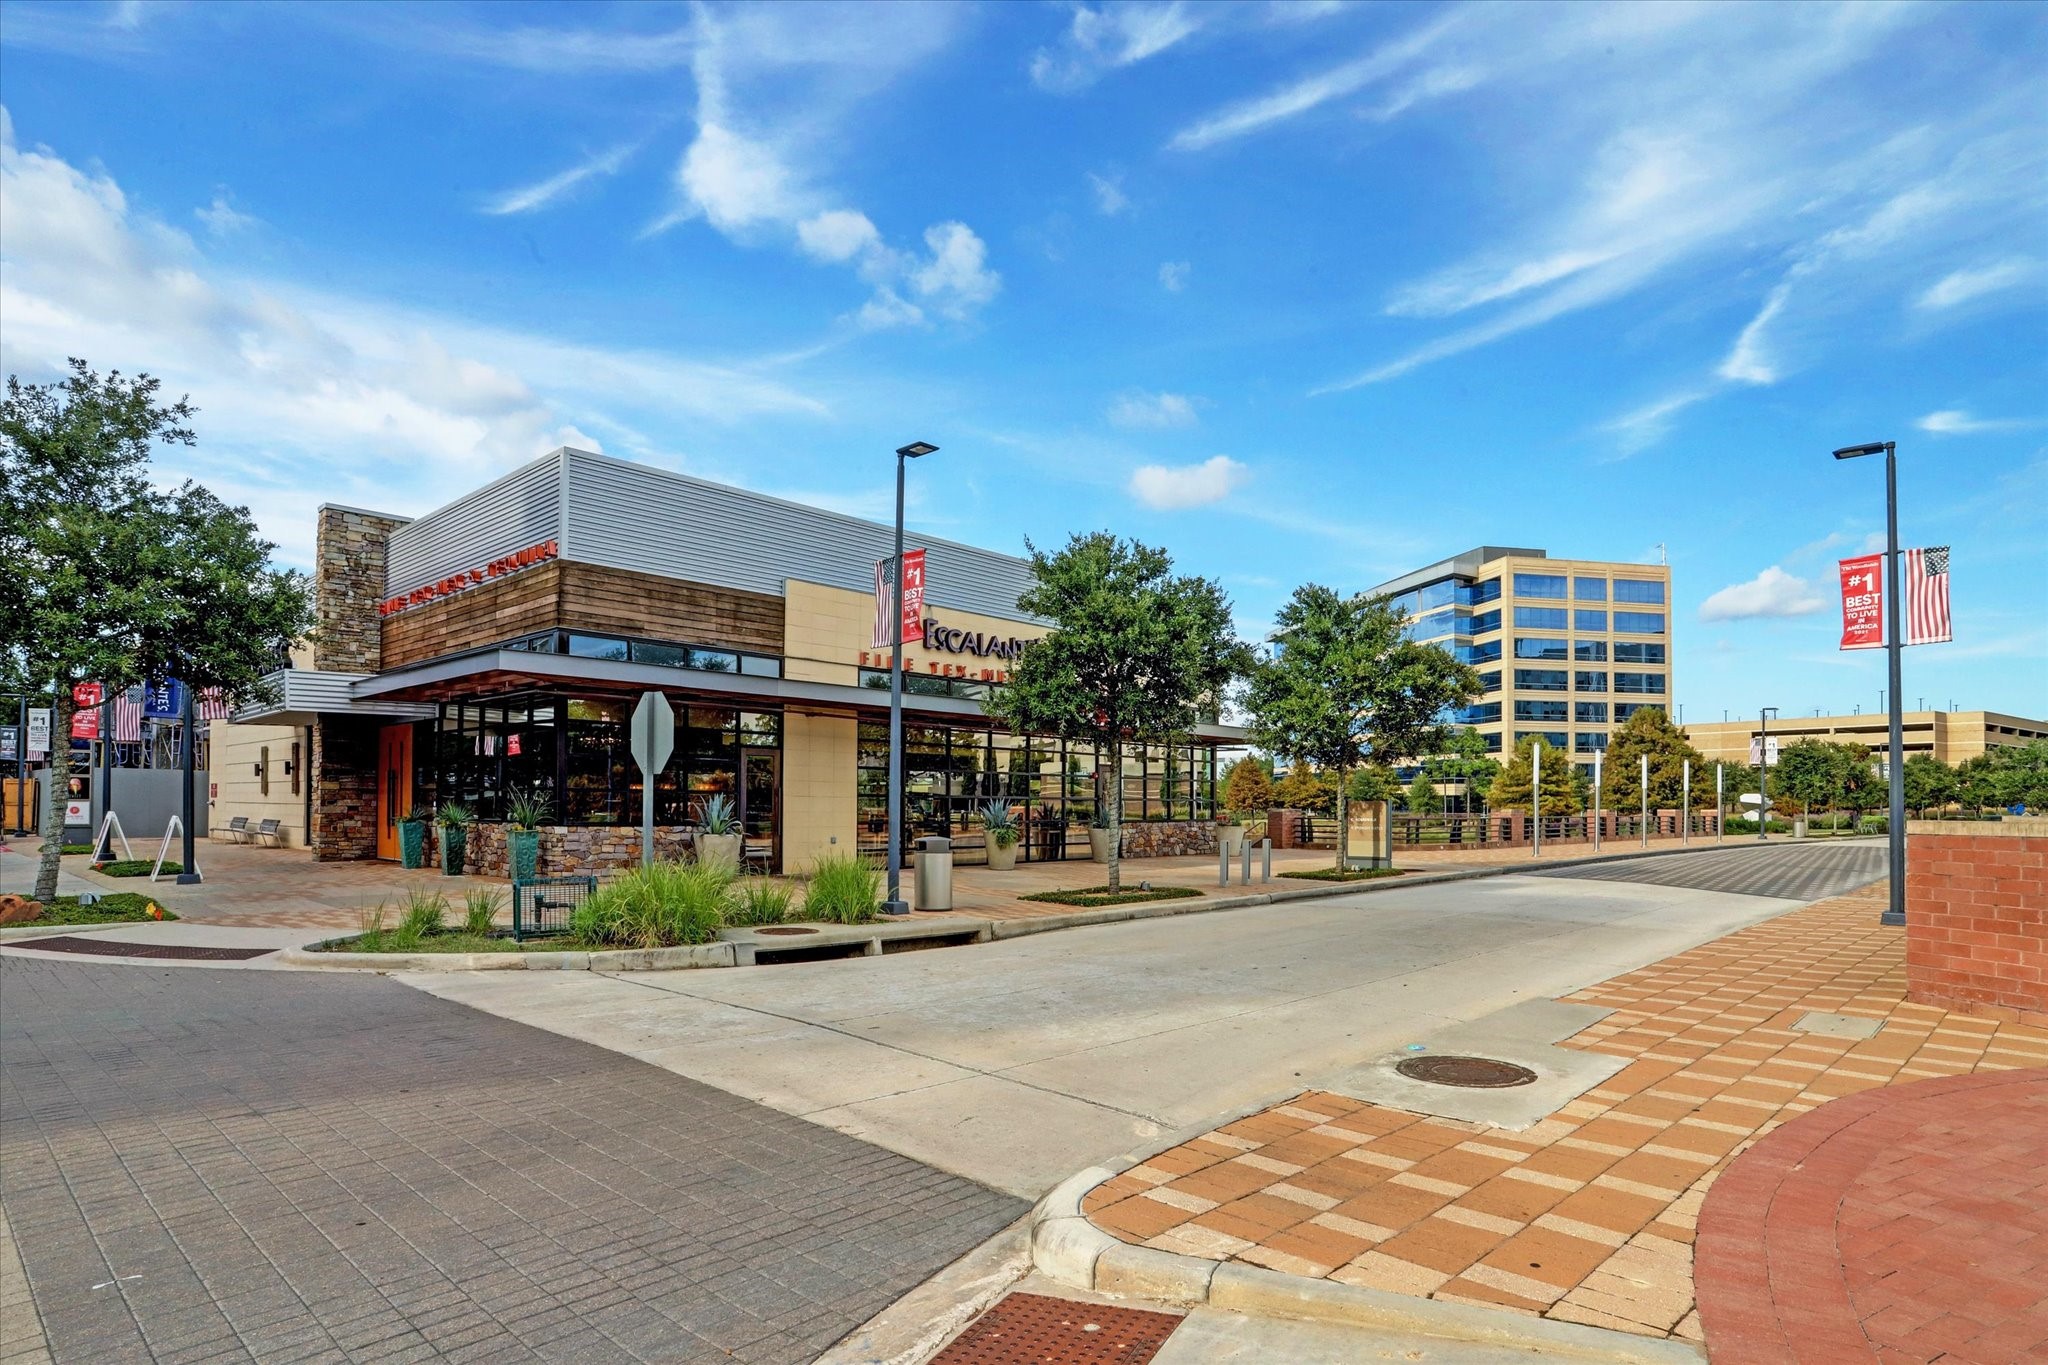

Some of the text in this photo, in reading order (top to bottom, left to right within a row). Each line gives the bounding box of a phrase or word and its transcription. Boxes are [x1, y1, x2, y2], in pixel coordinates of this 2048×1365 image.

[906, 567, 921, 585] #1
[1848, 572, 1873, 592] #1
[904, 587, 923, 600] BEST
[1845, 592, 1880, 608] BEST
[1845, 604, 1879, 613] COMMUNITY
[1846, 609, 1878, 620] TO LIVE
[1846, 623, 1879, 632] AMERICA
[922, 617, 1041, 661] ESCALANT
[929, 661, 1016, 684] TEX-ME
[79, 694, 95, 705] #1
[33, 716, 46, 725] #1
[3, 731, 15, 740] #1
